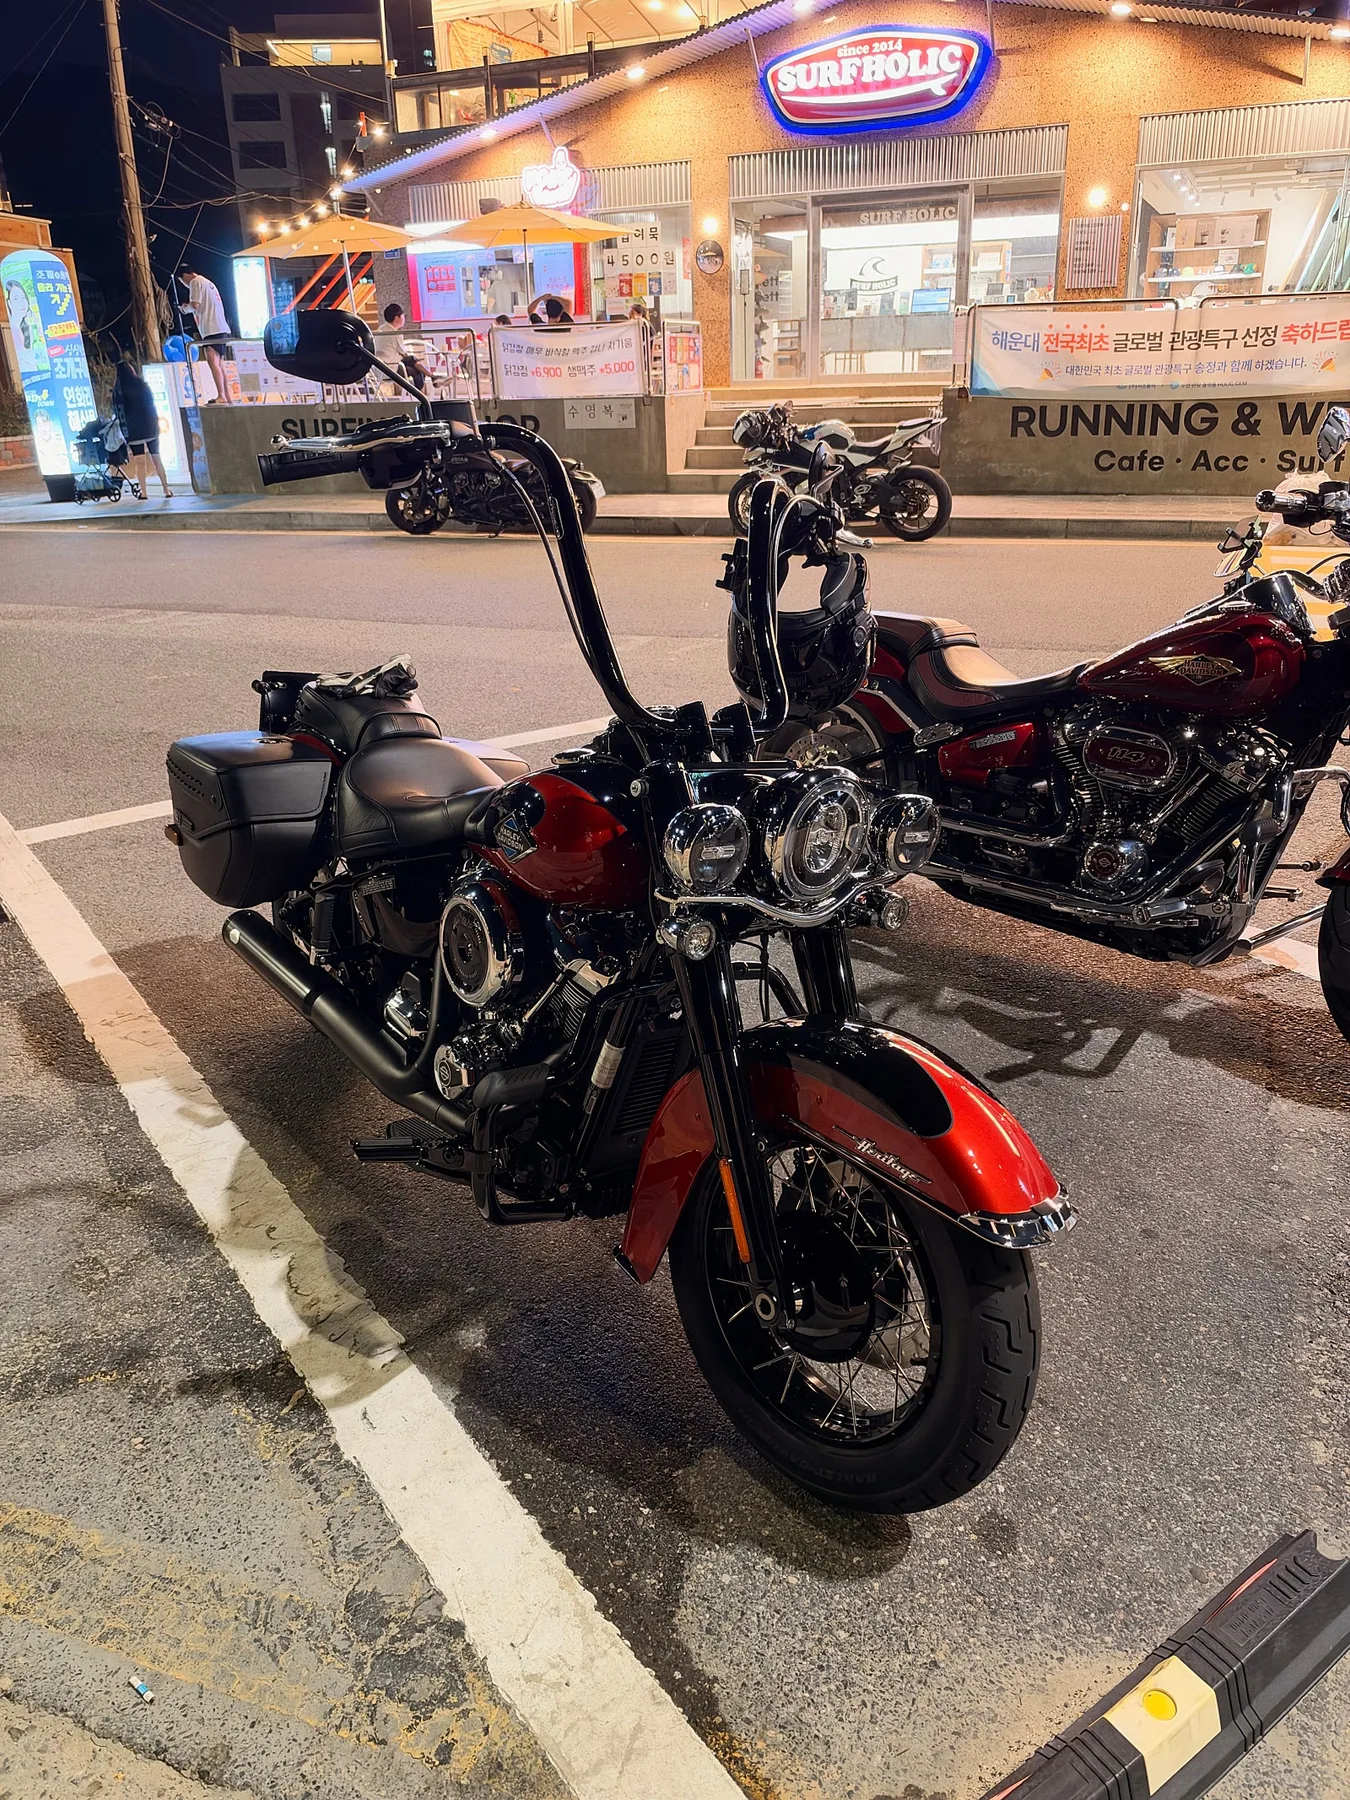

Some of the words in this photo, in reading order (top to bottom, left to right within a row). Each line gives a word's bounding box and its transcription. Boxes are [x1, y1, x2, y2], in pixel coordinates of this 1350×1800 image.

[837, 44, 869, 58] since
[872, 39, 903, 53] 2014
[502, 342, 524, 354] 닭강정
[526, 346, 543, 356] 매우
[572, 346, 588, 356] 맥주
[607, 338, 632, 351] 차가움
[992, 331, 1041, 353] 해운대
[1043, 332, 1109, 353] 전국최초
[1112, 331, 1163, 352] 글로벌
[1168, 328, 1239, 351] 관광특구
[1241, 325, 1279, 348] 선정
[503, 364, 528, 378] 닭강정
[568, 364, 597, 378] 생맥주
[1065, 365, 1102, 376] 대한민국
[1104, 365, 1122, 375] 최초
[1124, 364, 1152, 376] 글로벌
[1153, 363, 1192, 375] 관광특구
[1194, 360, 1228, 374] 송정과
[1230, 359, 1252, 373] 함께
[1254, 357, 1307, 371] 하겠습니다.
[567, 403, 614, 420] 수영복
[1010, 402, 1220, 437] RUNNING
[1231, 402, 1262, 436] &
[1094, 449, 1165, 473] Cafe
[1190, 449, 1250, 473] Acc
[1179, 667, 1224, 676] DAVIDSON
[1107, 746, 1146, 763] 114
[856, 1138, 920, 1182] Heritage
